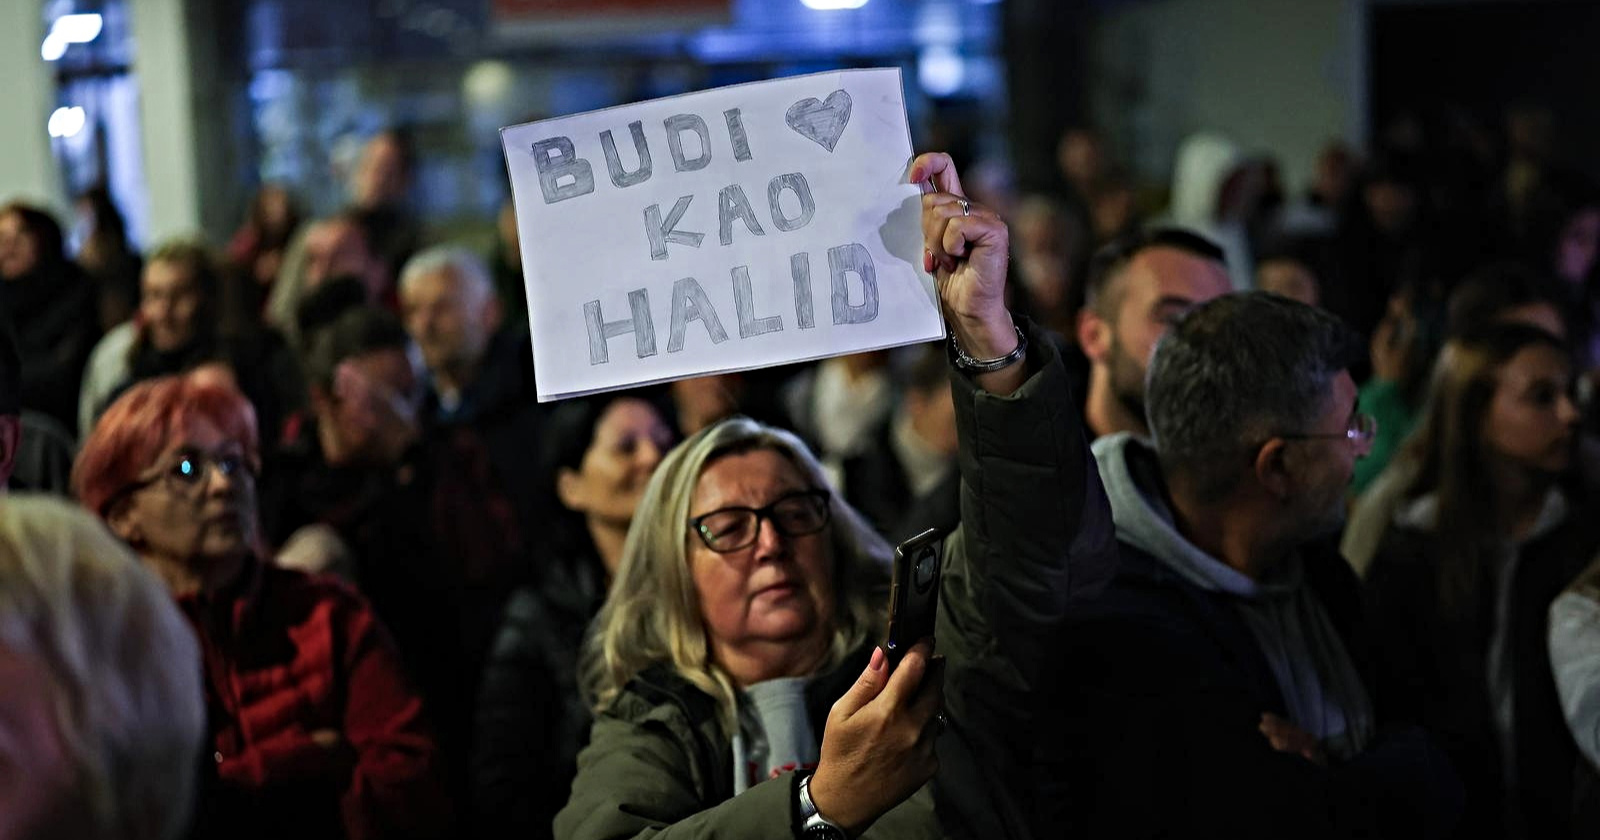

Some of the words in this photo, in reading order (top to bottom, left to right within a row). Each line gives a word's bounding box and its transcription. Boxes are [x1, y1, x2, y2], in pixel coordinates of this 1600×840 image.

[532, 107, 753, 204] BUDI
[643, 171, 816, 261] KAO
[583, 242, 879, 366] HALID
